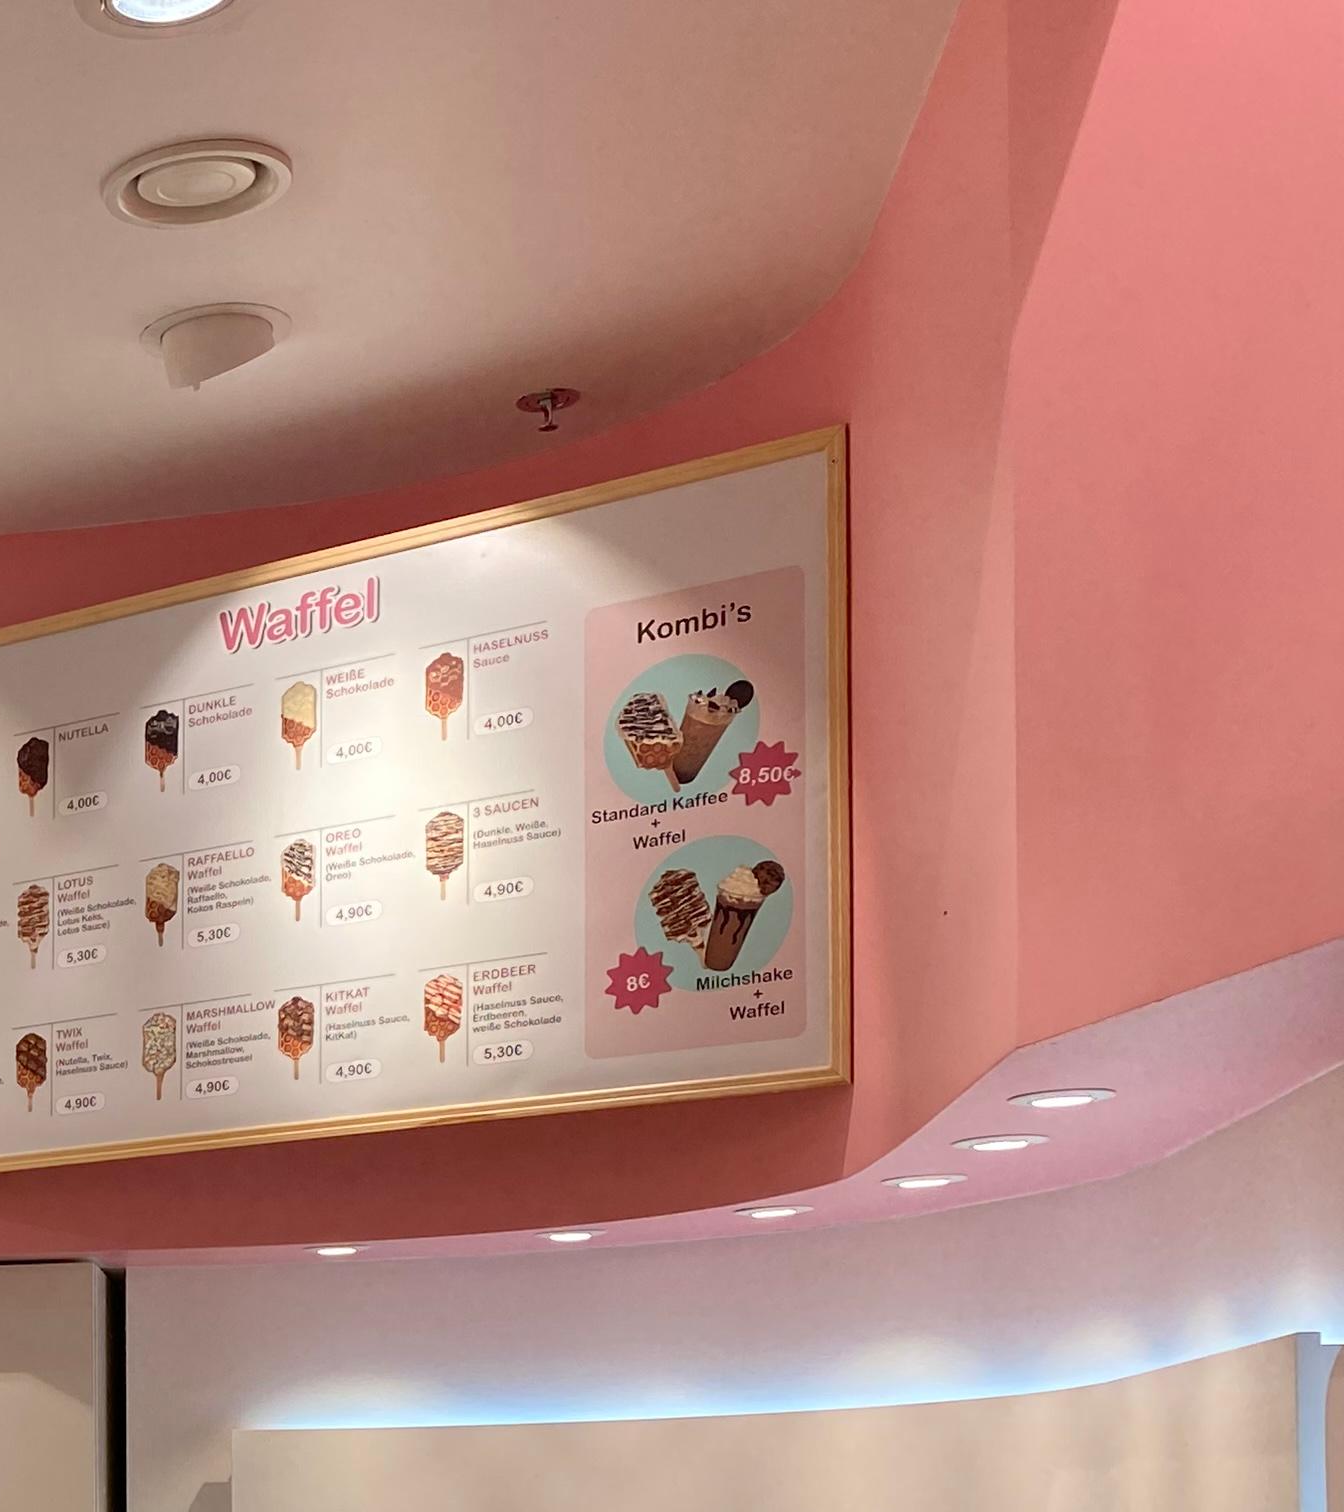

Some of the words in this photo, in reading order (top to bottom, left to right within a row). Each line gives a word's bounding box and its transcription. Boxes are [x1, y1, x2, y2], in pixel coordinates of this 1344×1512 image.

[220, 576, 380, 652] Waffel
[637, 603, 752, 643] Kombi's
[474, 630, 548, 654] HASELNUSS
[473, 653, 510, 668] Sauce
[326, 676, 394, 699] Schokolade
[189, 696, 236, 714] DUNKLE
[188, 705, 253, 727] Schokolade
[484, 712, 523, 730] 4,00€
[59, 723, 109, 742] NUTELLA
[336, 742, 373, 759] 4,00€
[197, 769, 232, 785] 4,00€
[738, 766, 795, 785] 8,50€
[67, 795, 99, 811] 4,00€
[473, 807, 480, 817] 3
[484, 798, 539, 816] SAUCEN
[591, 800, 667, 824] Standard
[672, 791, 728, 811] Kaffee
[326, 828, 361, 843] OREO
[632, 830, 686, 850] Waffel
[187, 846, 255, 868] RAFFAELLO
[58, 876, 93, 891] LOTUS
[484, 881, 523, 898] 4,90€
[57, 890, 90, 903] Waffel
[336, 905, 372, 921] 4,90€
[197, 927, 231, 942] 5,30€
[473, 964, 536, 981] ERDBEER
[696, 967, 793, 991] Milchshake
[473, 982, 512, 996] Waffel
[627, 975, 650, 991] 8€
[325, 987, 370, 1001] KITKAT
[186, 999, 276, 1022] MARSHMALLOW
[729, 1002, 785, 1020] Waffel
[56, 1027, 82, 1039] TWIX
[483, 1044, 523, 1060] 5,30€
